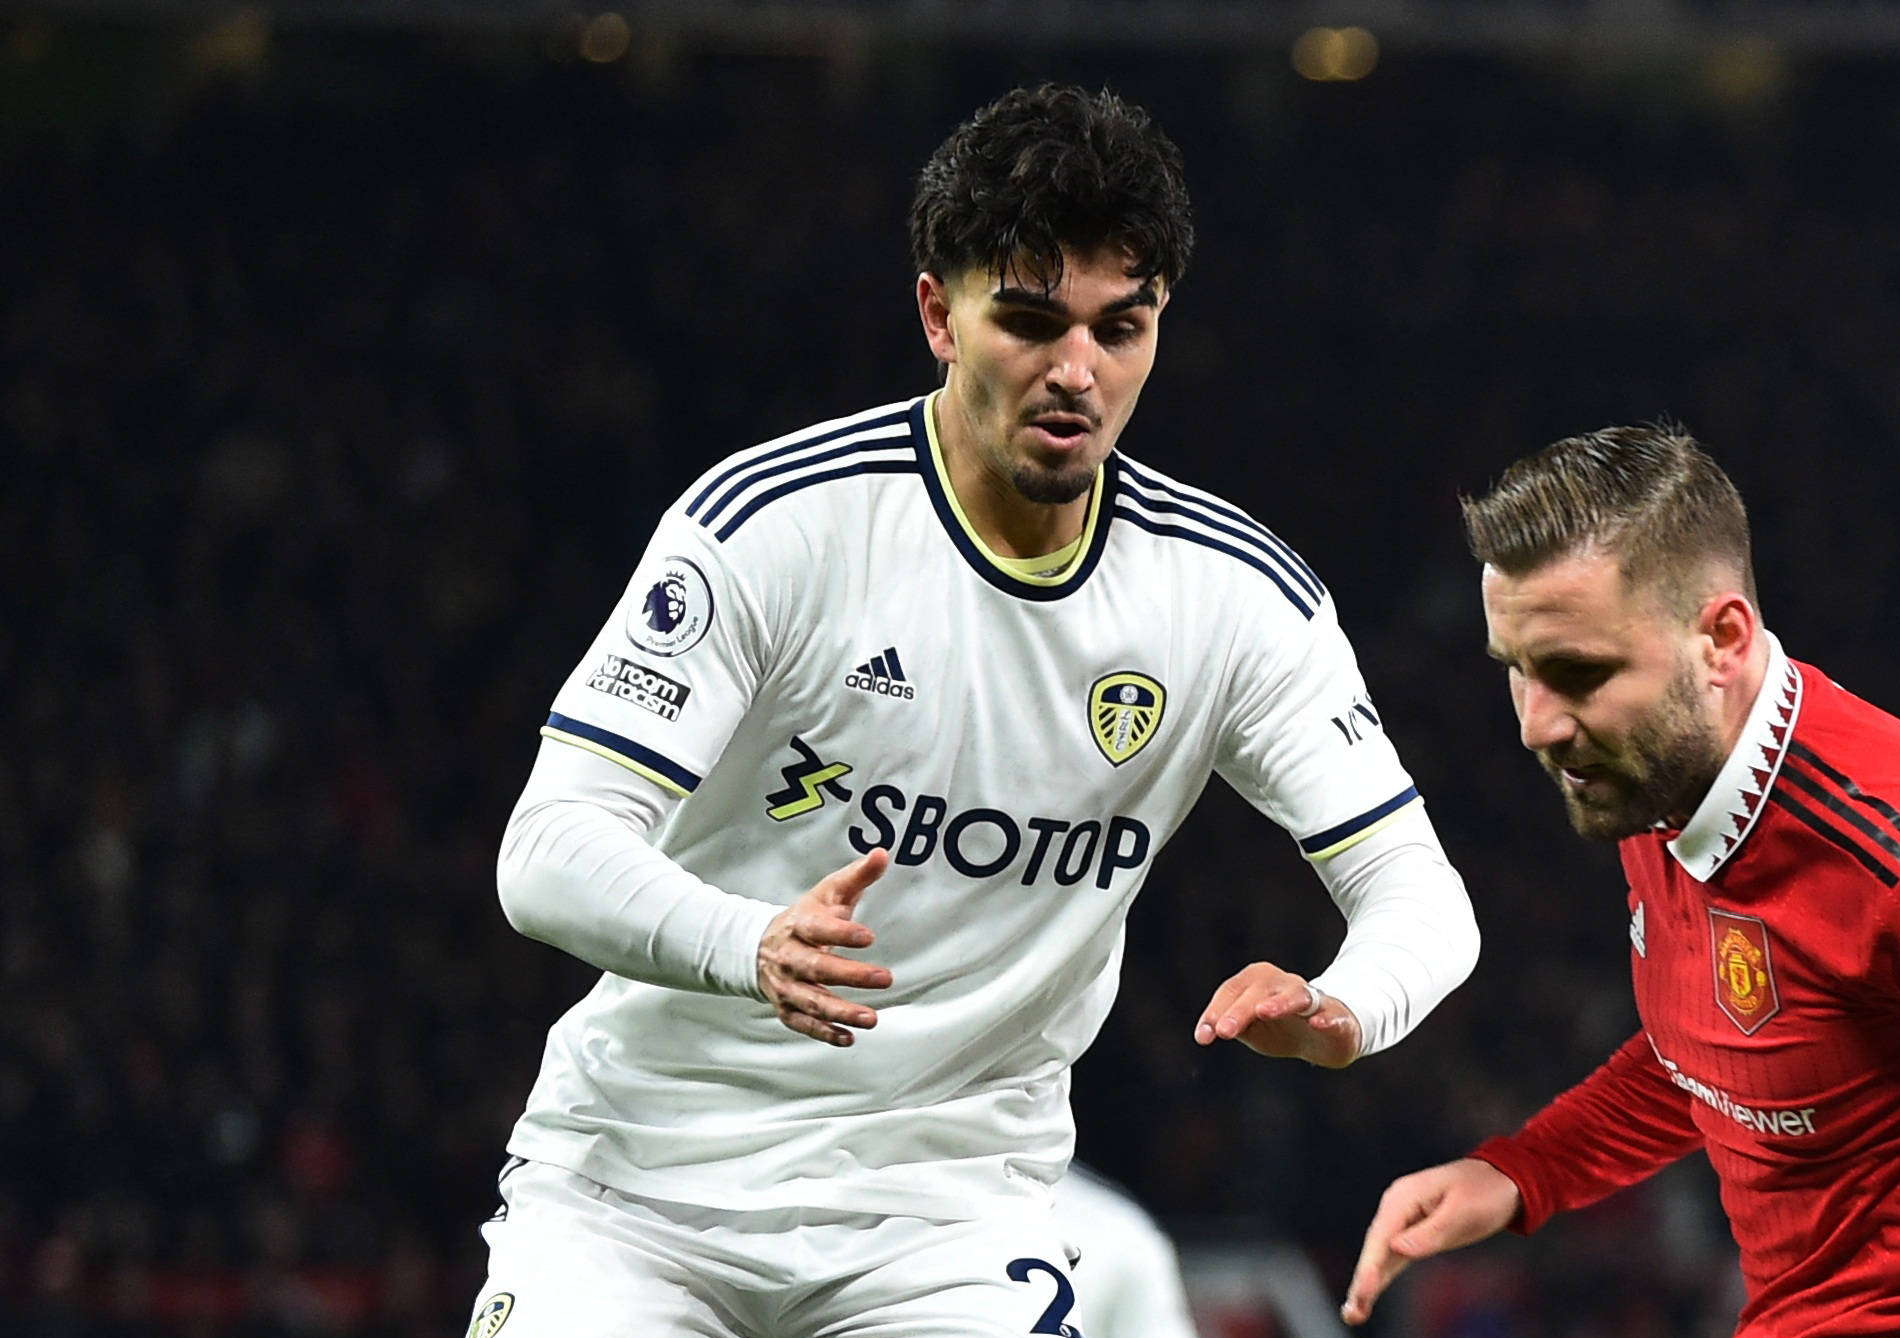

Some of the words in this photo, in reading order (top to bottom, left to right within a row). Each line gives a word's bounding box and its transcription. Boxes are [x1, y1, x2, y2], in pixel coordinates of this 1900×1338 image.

[620, 664, 679, 702] room
[845, 673, 914, 700] adidas
[848, 784, 1152, 890] SBOTOP
